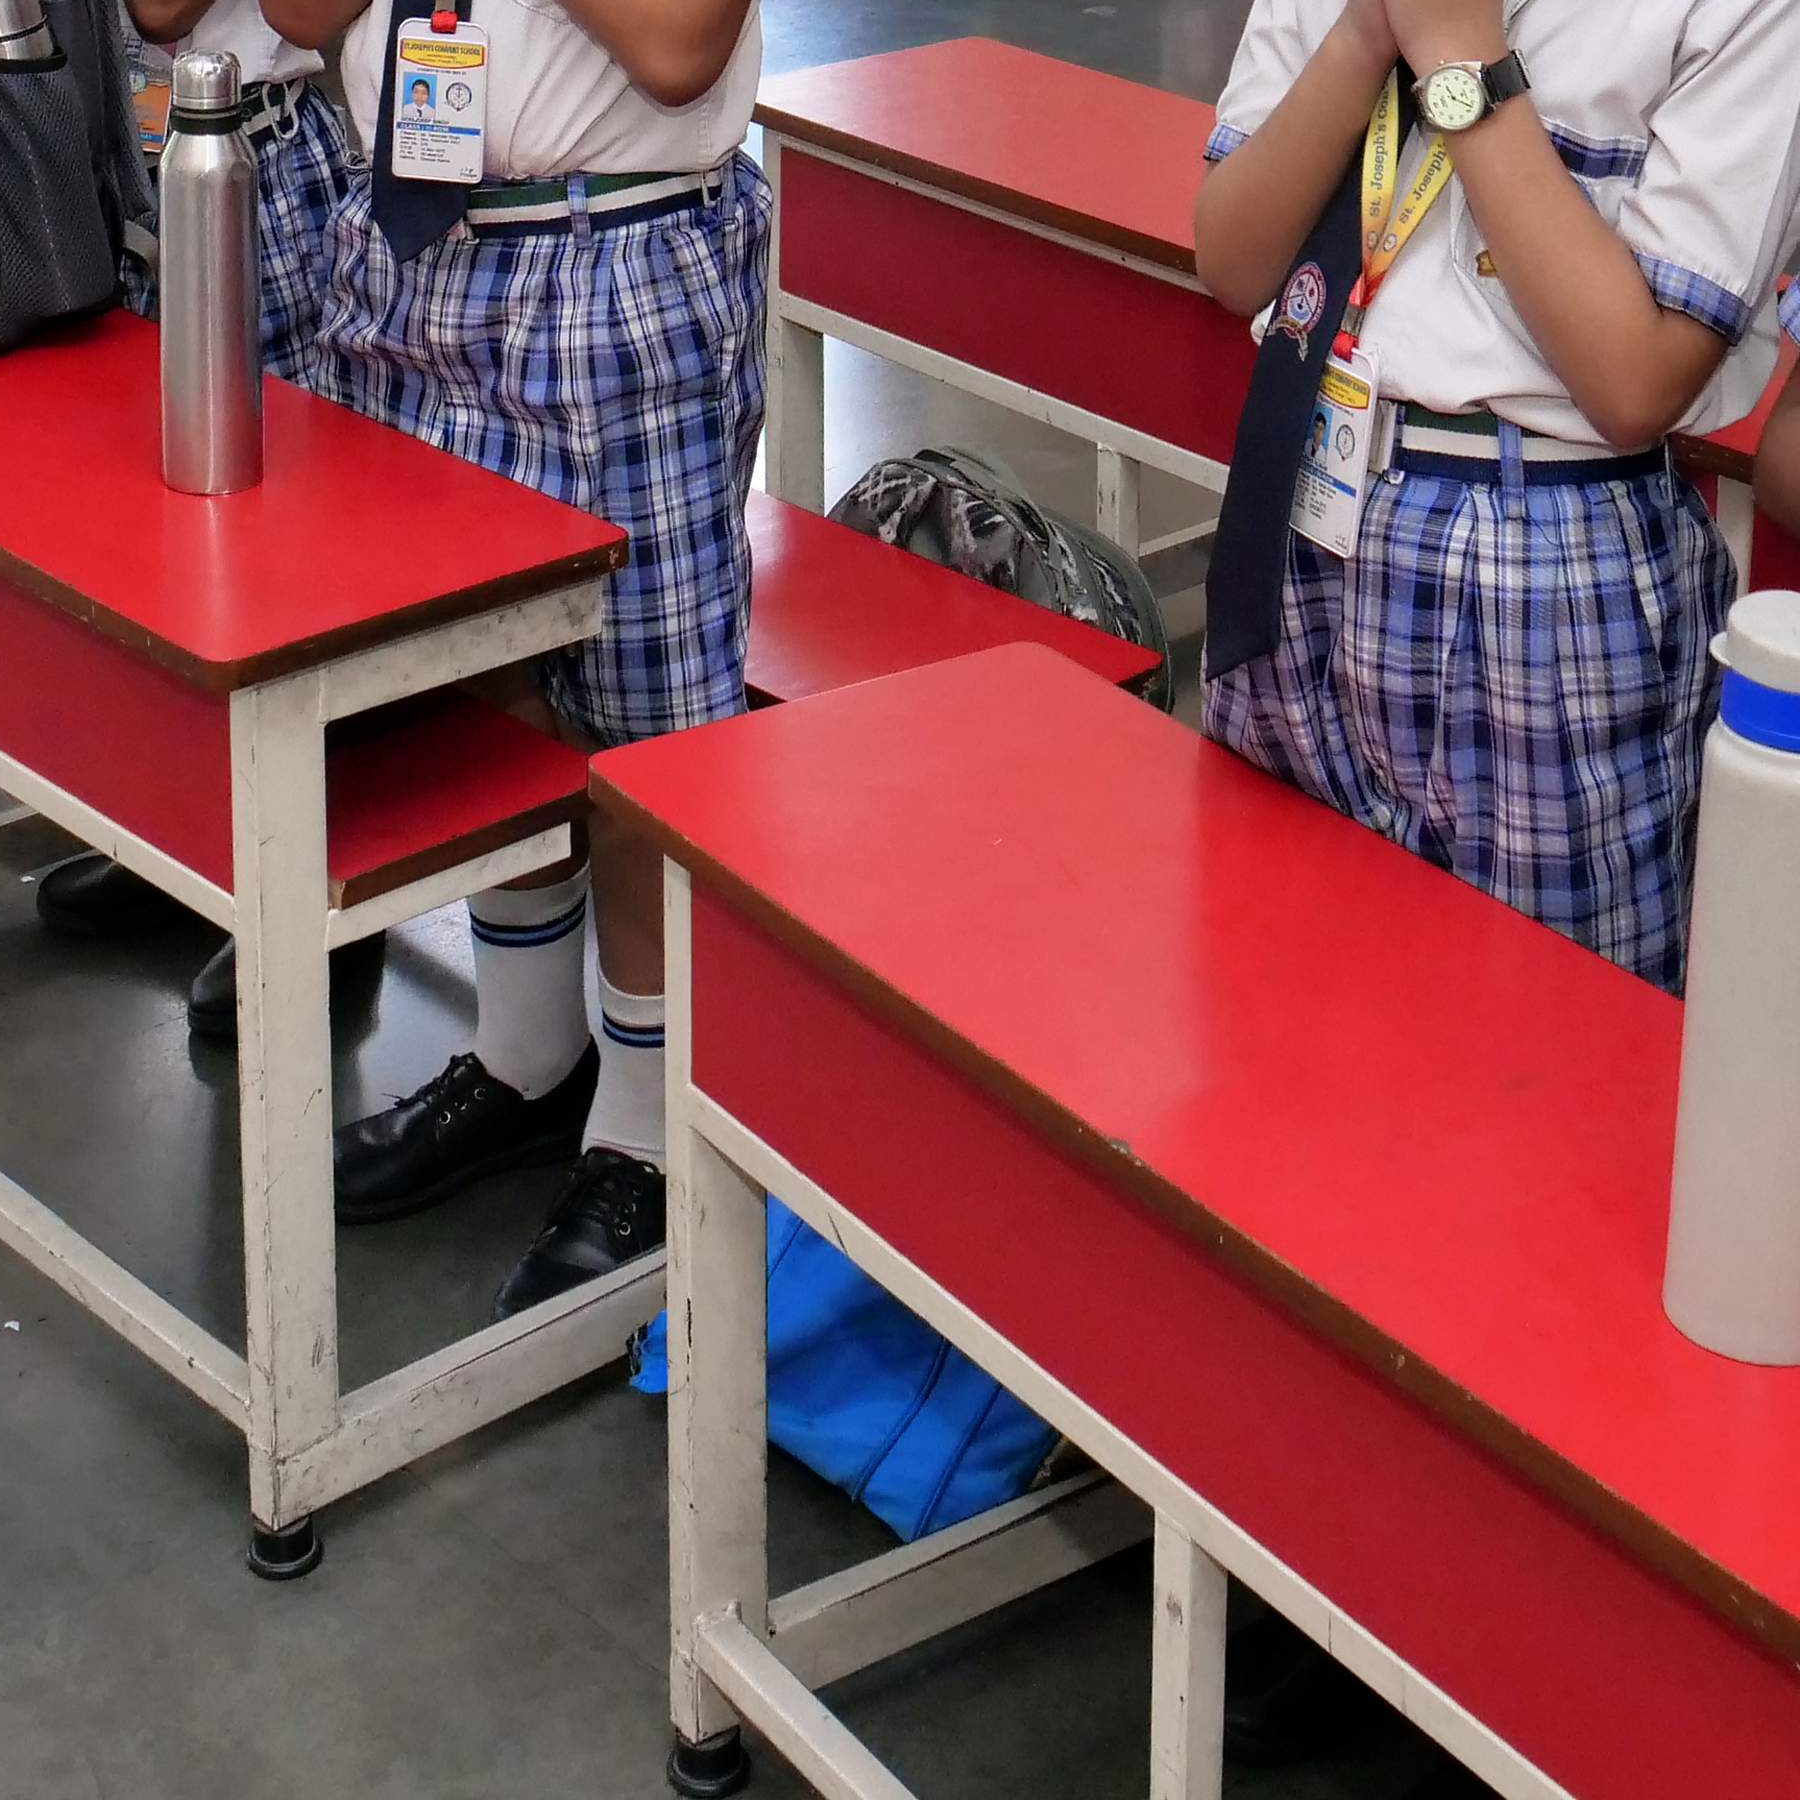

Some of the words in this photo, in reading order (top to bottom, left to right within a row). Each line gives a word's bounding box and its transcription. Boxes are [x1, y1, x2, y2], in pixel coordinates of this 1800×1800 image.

[1370, 123, 1388, 191] Joseph's
[1370, 195, 1383, 218] St.
[1400, 204, 1416, 224] St.
